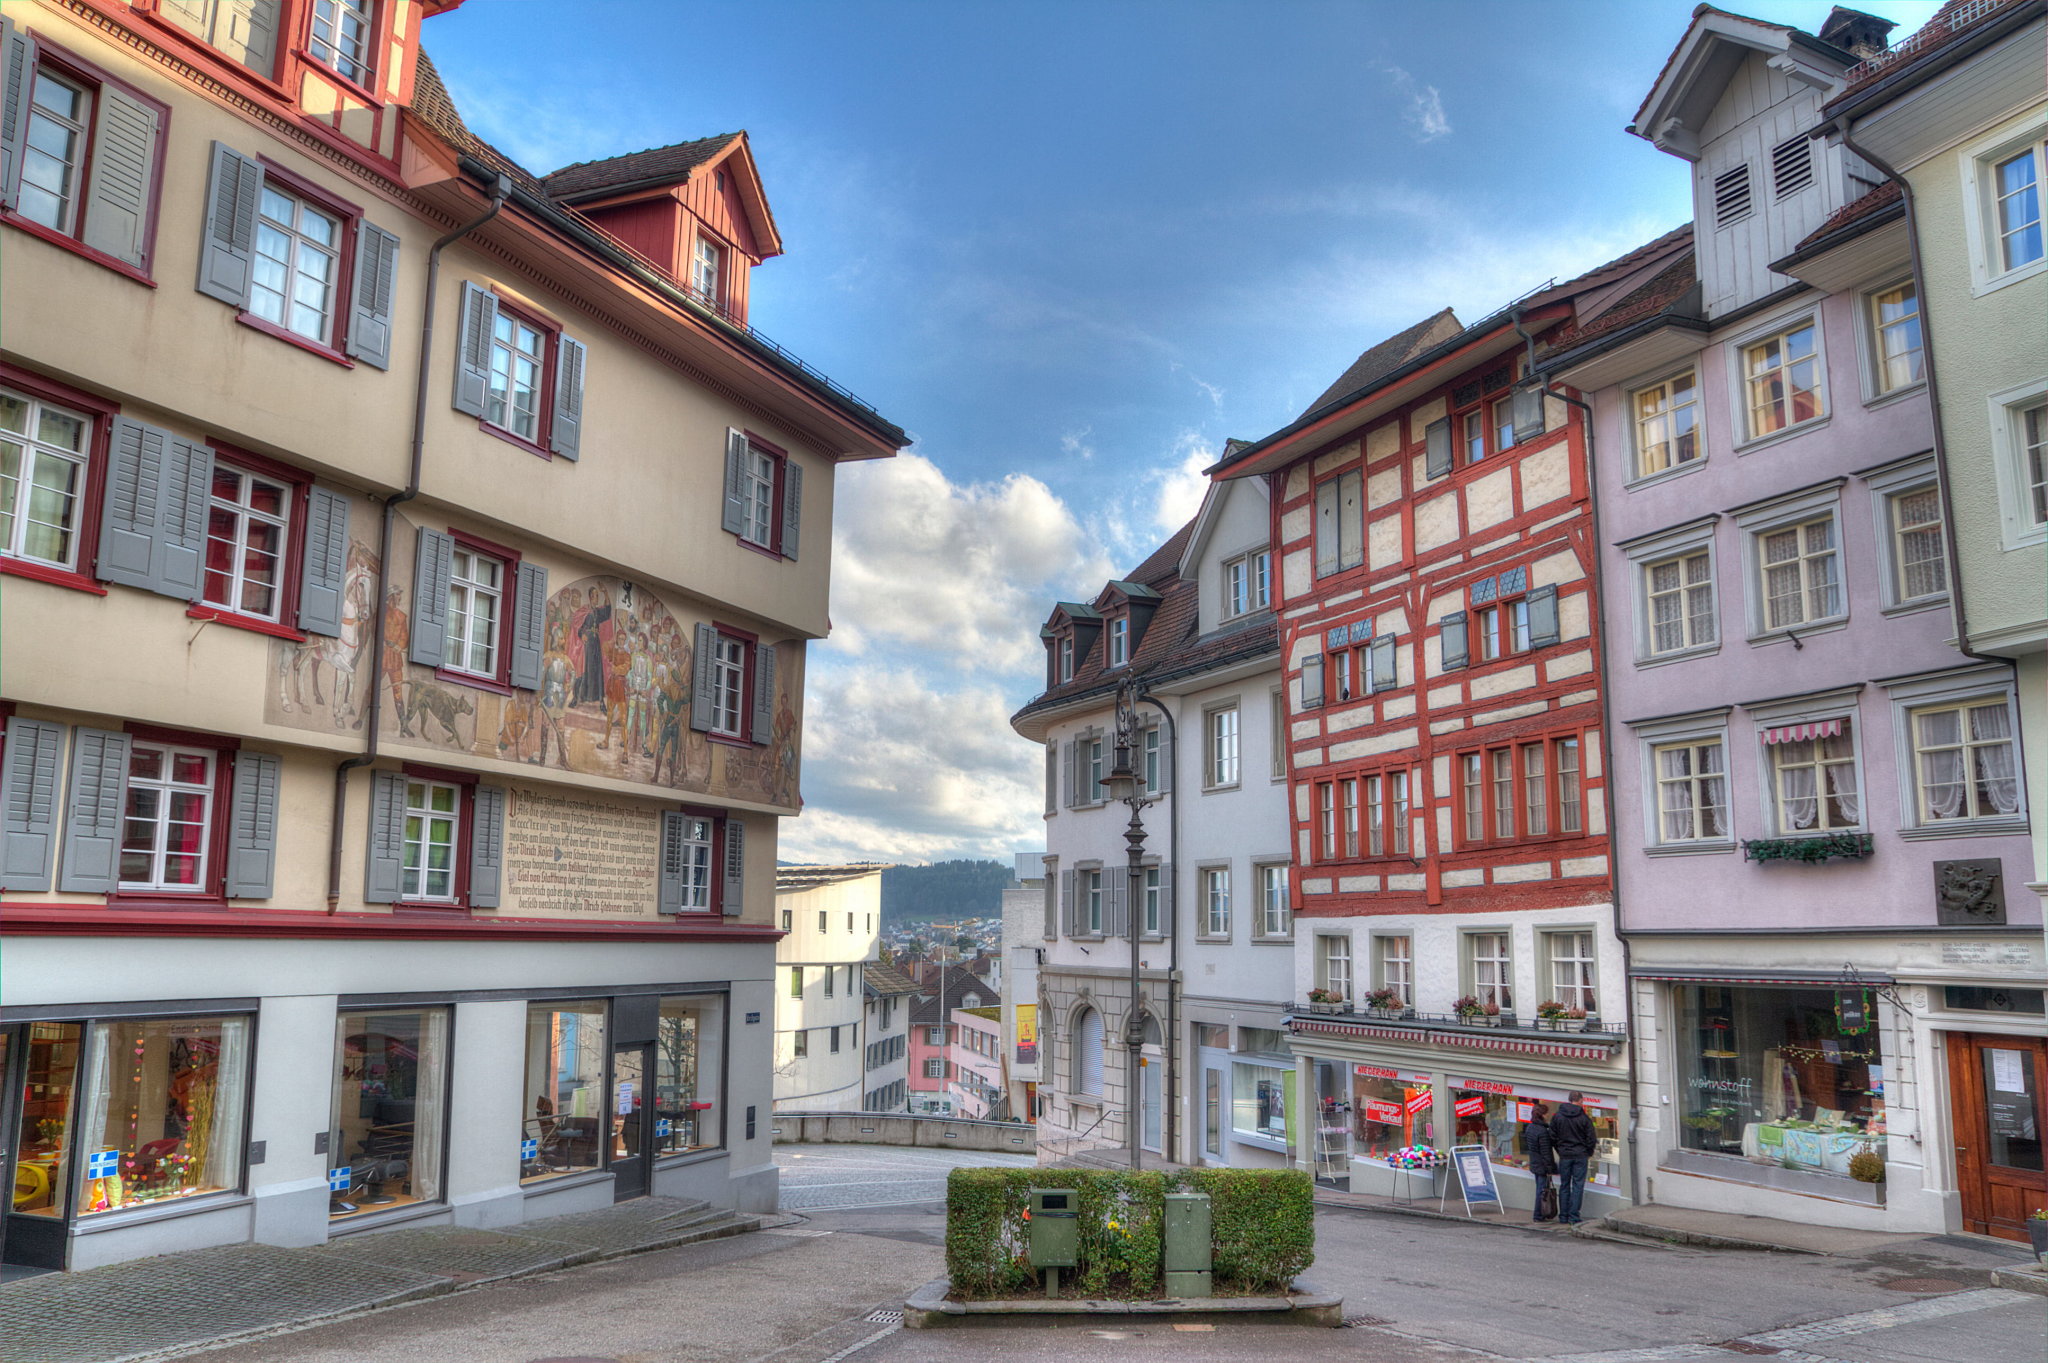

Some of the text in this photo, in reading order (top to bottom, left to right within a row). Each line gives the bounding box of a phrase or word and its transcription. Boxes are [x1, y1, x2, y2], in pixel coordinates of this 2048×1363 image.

[1357, 1065, 1399, 1079] NIEDERMANN
[1464, 1079, 1514, 1095] NIEDERMANN
[1688, 1075, 1752, 1098] wohnstoff
[1379, 1111, 1402, 1123] Verkauf
